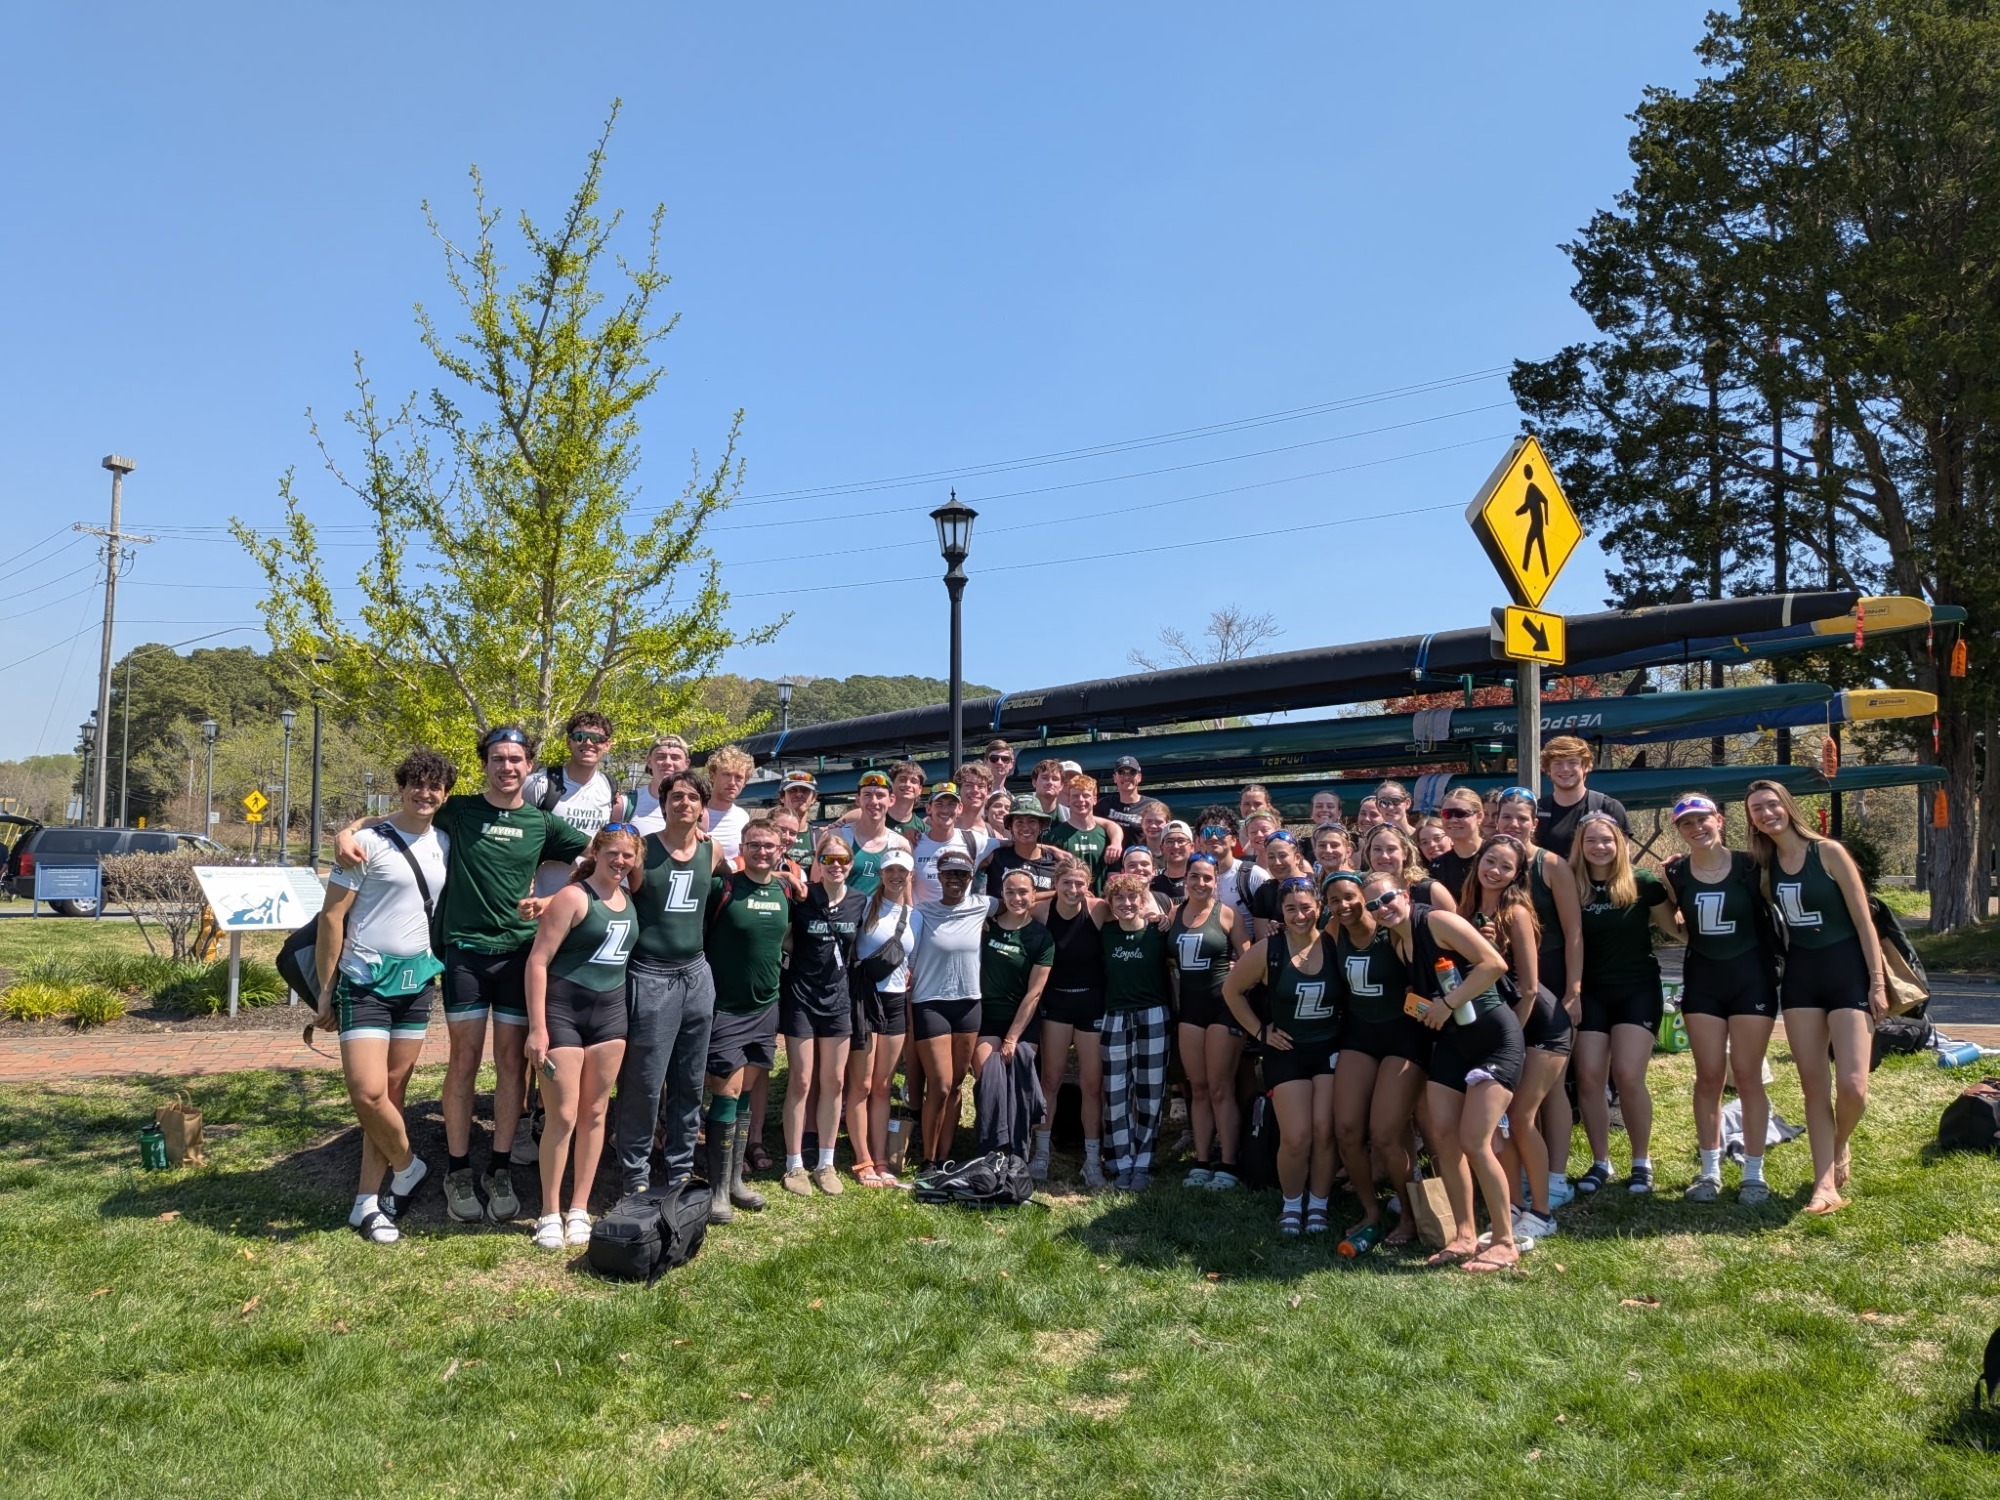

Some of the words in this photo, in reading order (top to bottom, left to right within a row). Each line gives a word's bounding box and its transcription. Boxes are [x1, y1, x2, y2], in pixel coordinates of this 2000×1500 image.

[1540, 713, 1602, 730] VESPO
[664, 870, 699, 912] L
[1776, 882, 1823, 927] L
[1694, 892, 1736, 935] L
[588, 920, 631, 965] L
[1112, 946, 1143, 961] Loyola
[1176, 932, 1212, 970] L
[401, 969, 418, 990] L
[1345, 956, 1383, 996] L
[1294, 981, 1334, 1019] L
